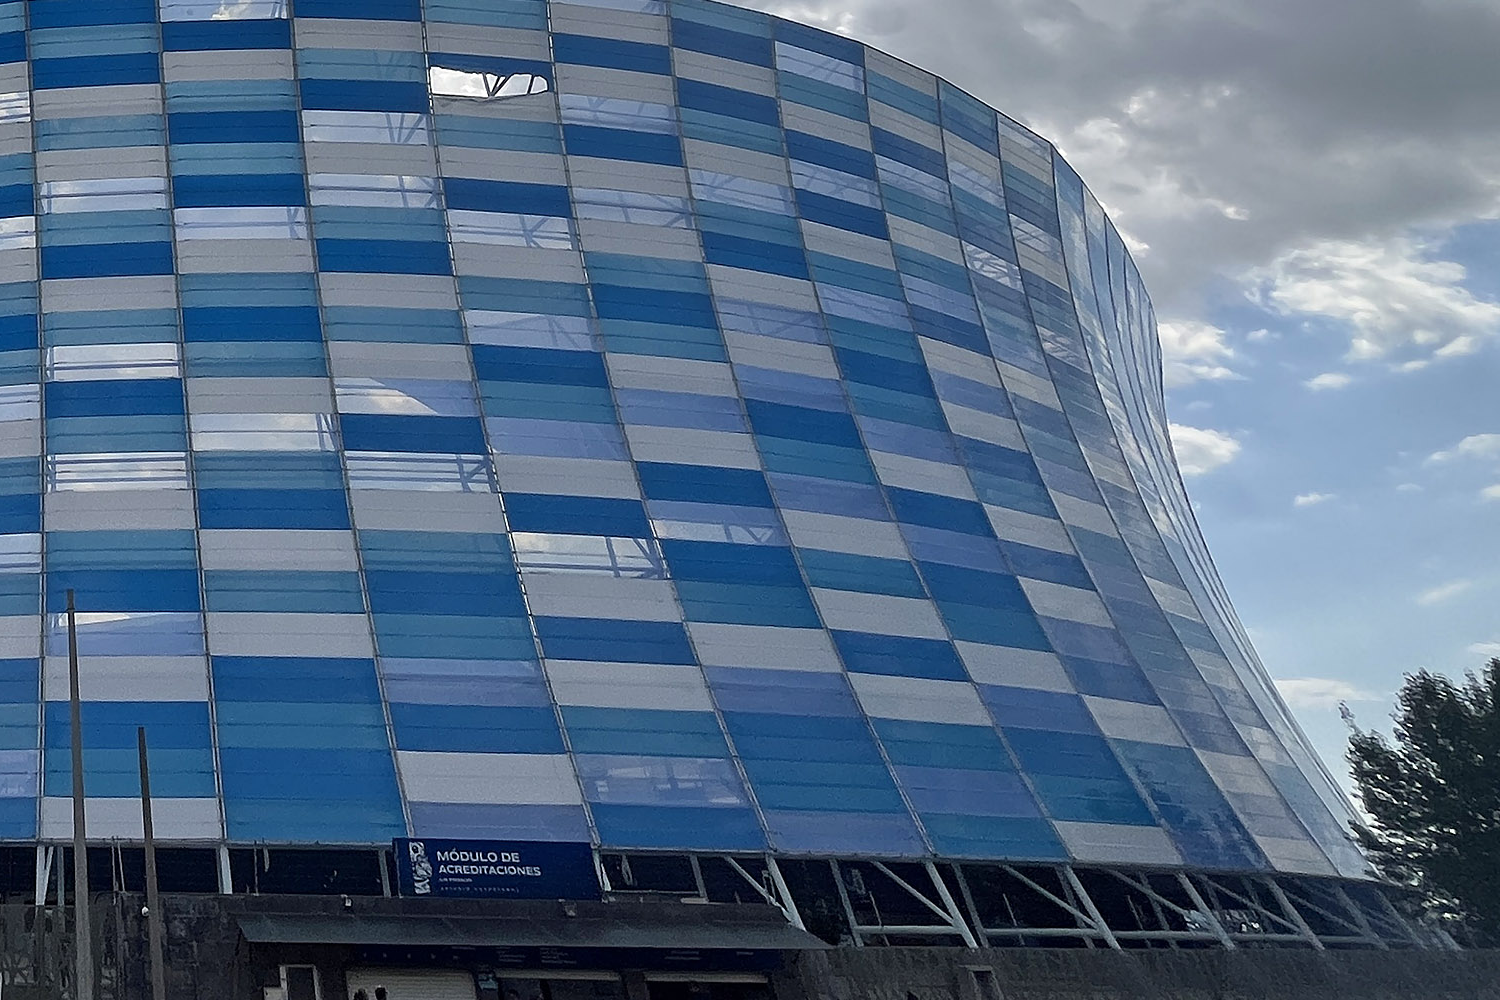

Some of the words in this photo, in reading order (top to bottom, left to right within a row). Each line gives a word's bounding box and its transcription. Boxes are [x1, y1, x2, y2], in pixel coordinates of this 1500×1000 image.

[436, 848, 498, 863] MÓDULO
[501, 852, 520, 863] DE
[438, 864, 541, 876] ACREDITACIONES
